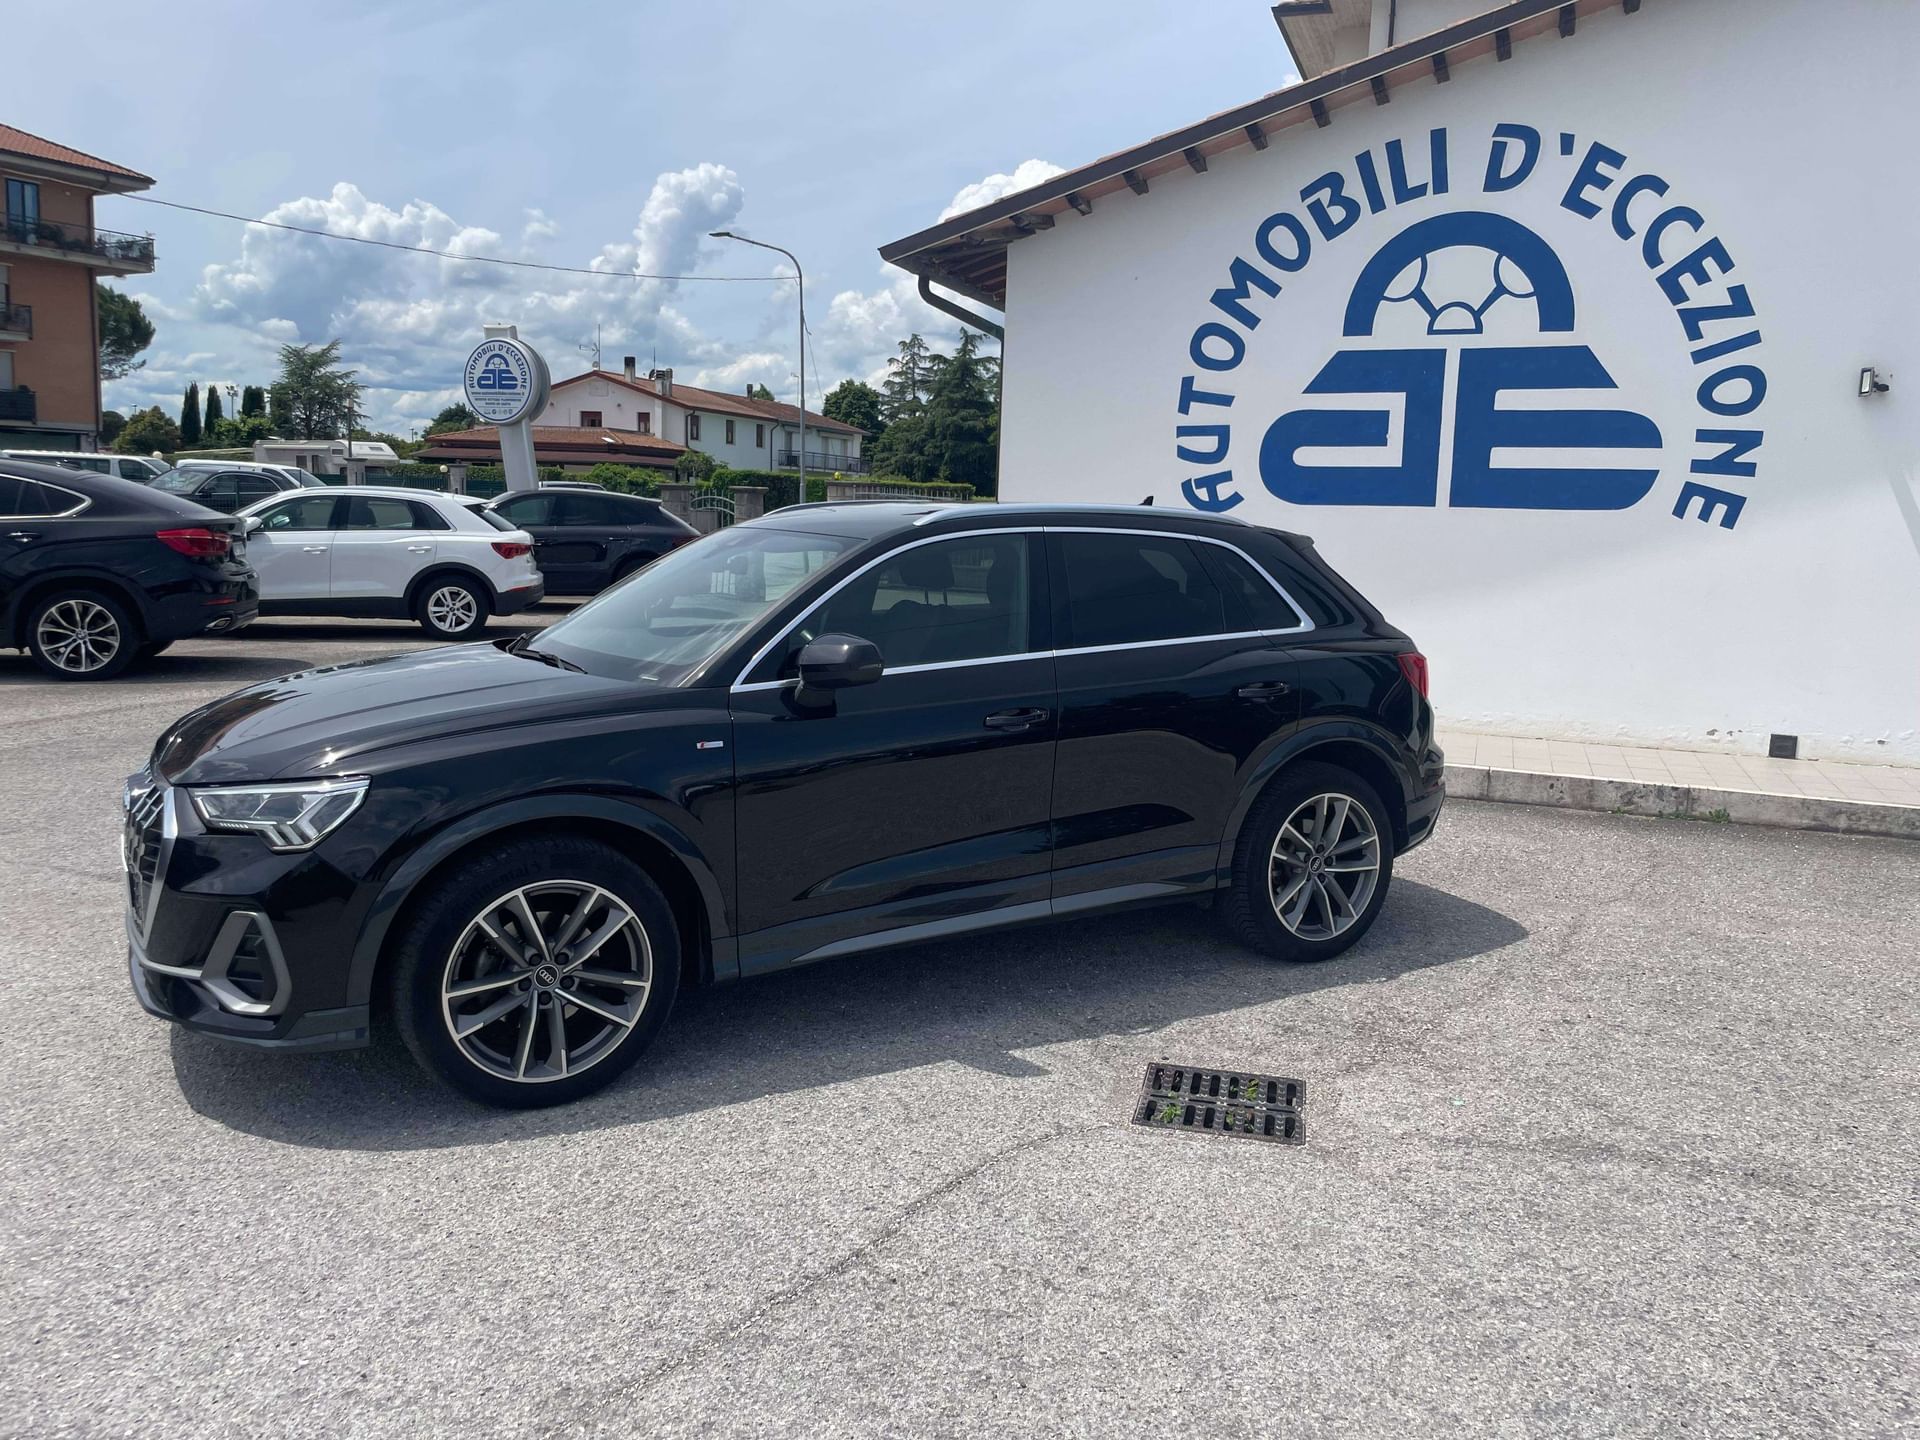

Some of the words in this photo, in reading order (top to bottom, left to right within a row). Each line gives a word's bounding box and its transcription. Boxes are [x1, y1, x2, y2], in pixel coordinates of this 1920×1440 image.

[468, 344, 496, 389] AUTOMOBILI
[498, 344, 527, 390] D'ECCEZIONE
[1176, 127, 1449, 513] AUTOMOBILI
[1484, 124, 1767, 530] D'ECCEZIONE
